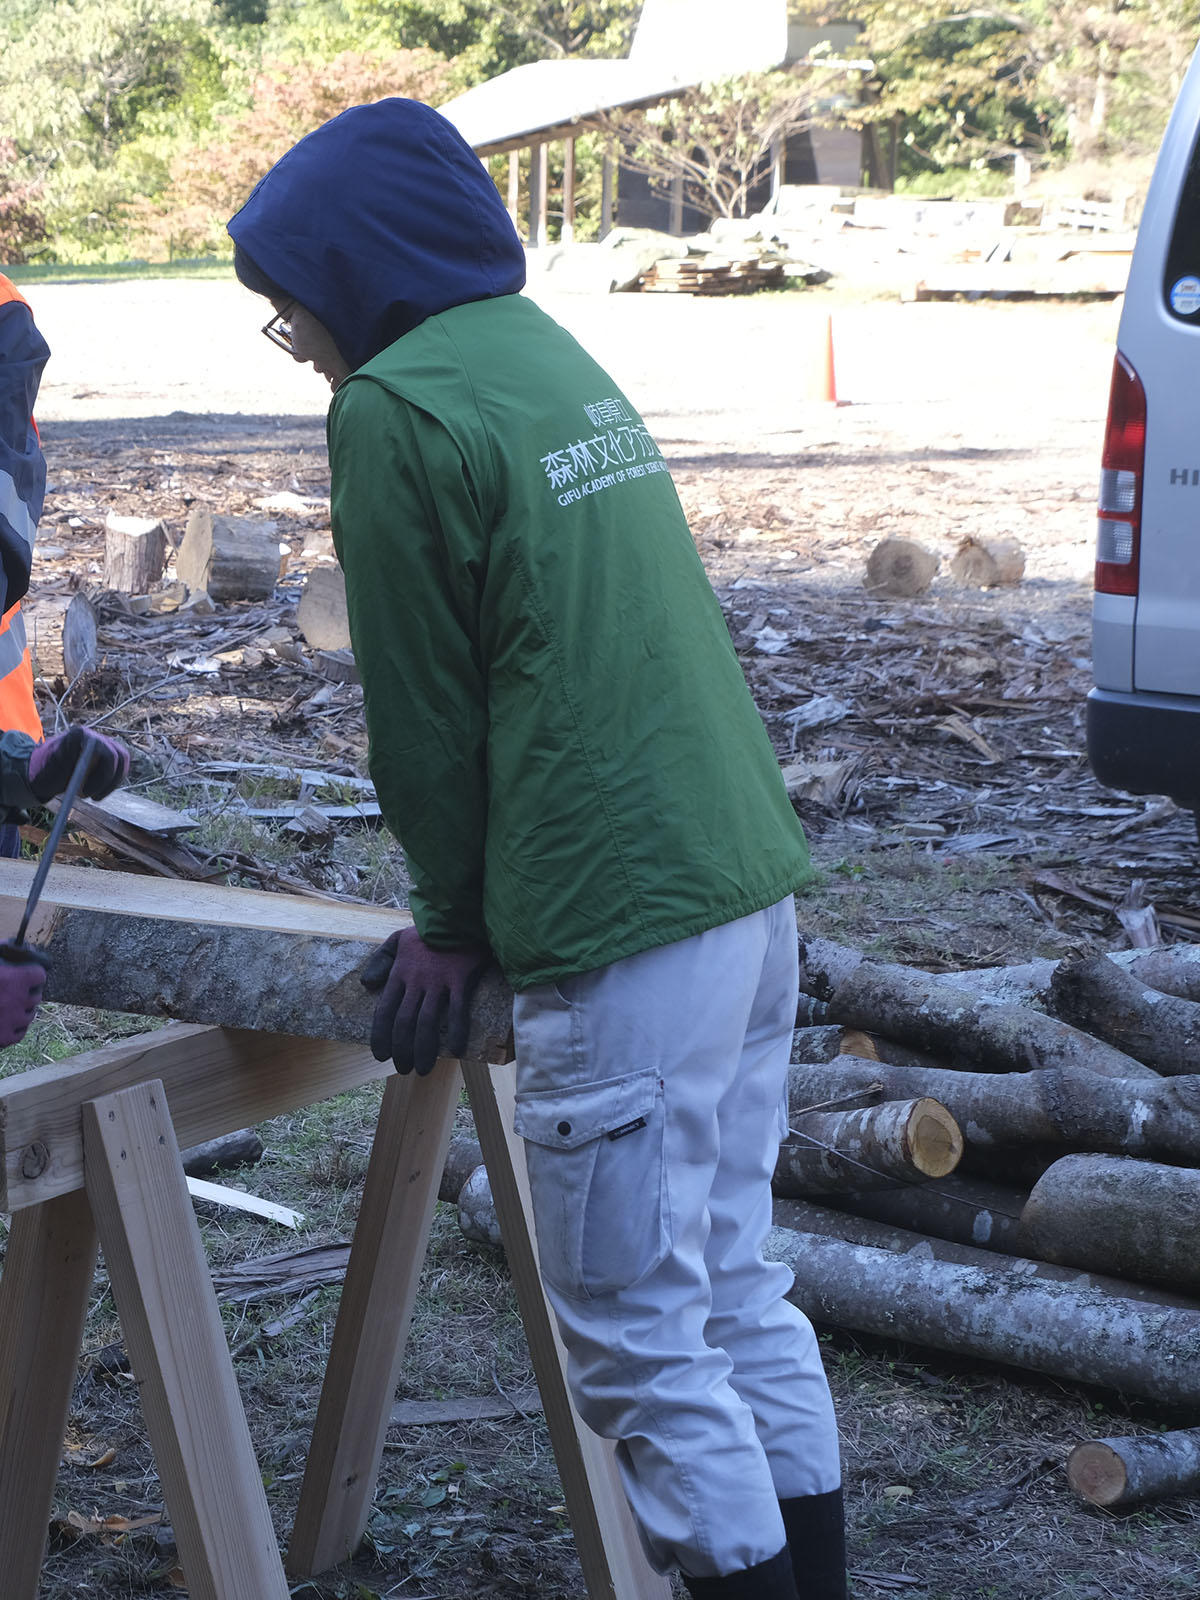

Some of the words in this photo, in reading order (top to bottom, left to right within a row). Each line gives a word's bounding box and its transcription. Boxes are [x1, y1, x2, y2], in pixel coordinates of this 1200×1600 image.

[583, 397, 632, 428] 岐阜県立
[557, 487, 582, 507] GIFU
[581, 472, 617, 497] ACADEMY
[615, 469, 627, 483] OF
[625, 464, 647, 480] FOREST
